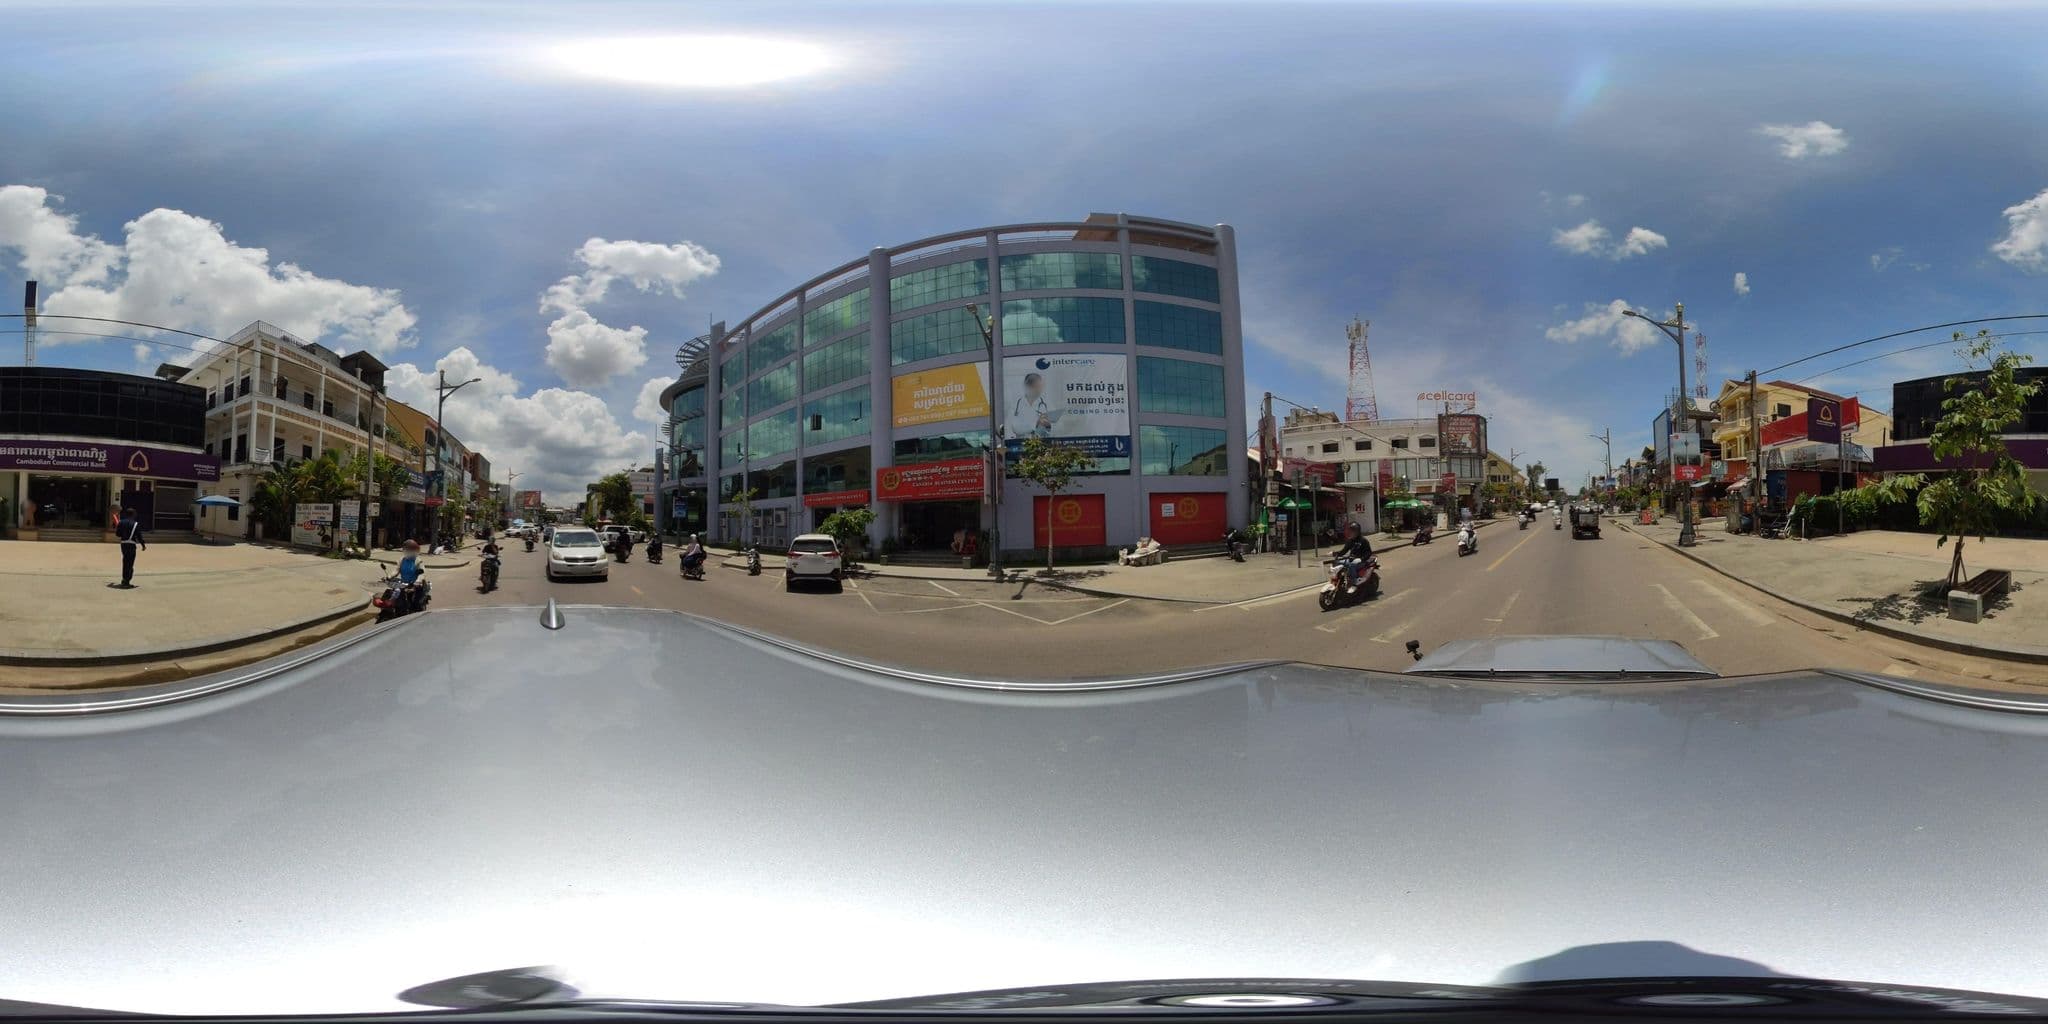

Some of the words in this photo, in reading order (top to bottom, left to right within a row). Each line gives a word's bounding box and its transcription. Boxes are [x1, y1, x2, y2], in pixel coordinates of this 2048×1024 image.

[1066, 381, 1124, 396] មកដល់ក្នុង
[1426, 391, 1475, 401] cellcard
[52, 459, 89, 467] Commercial
